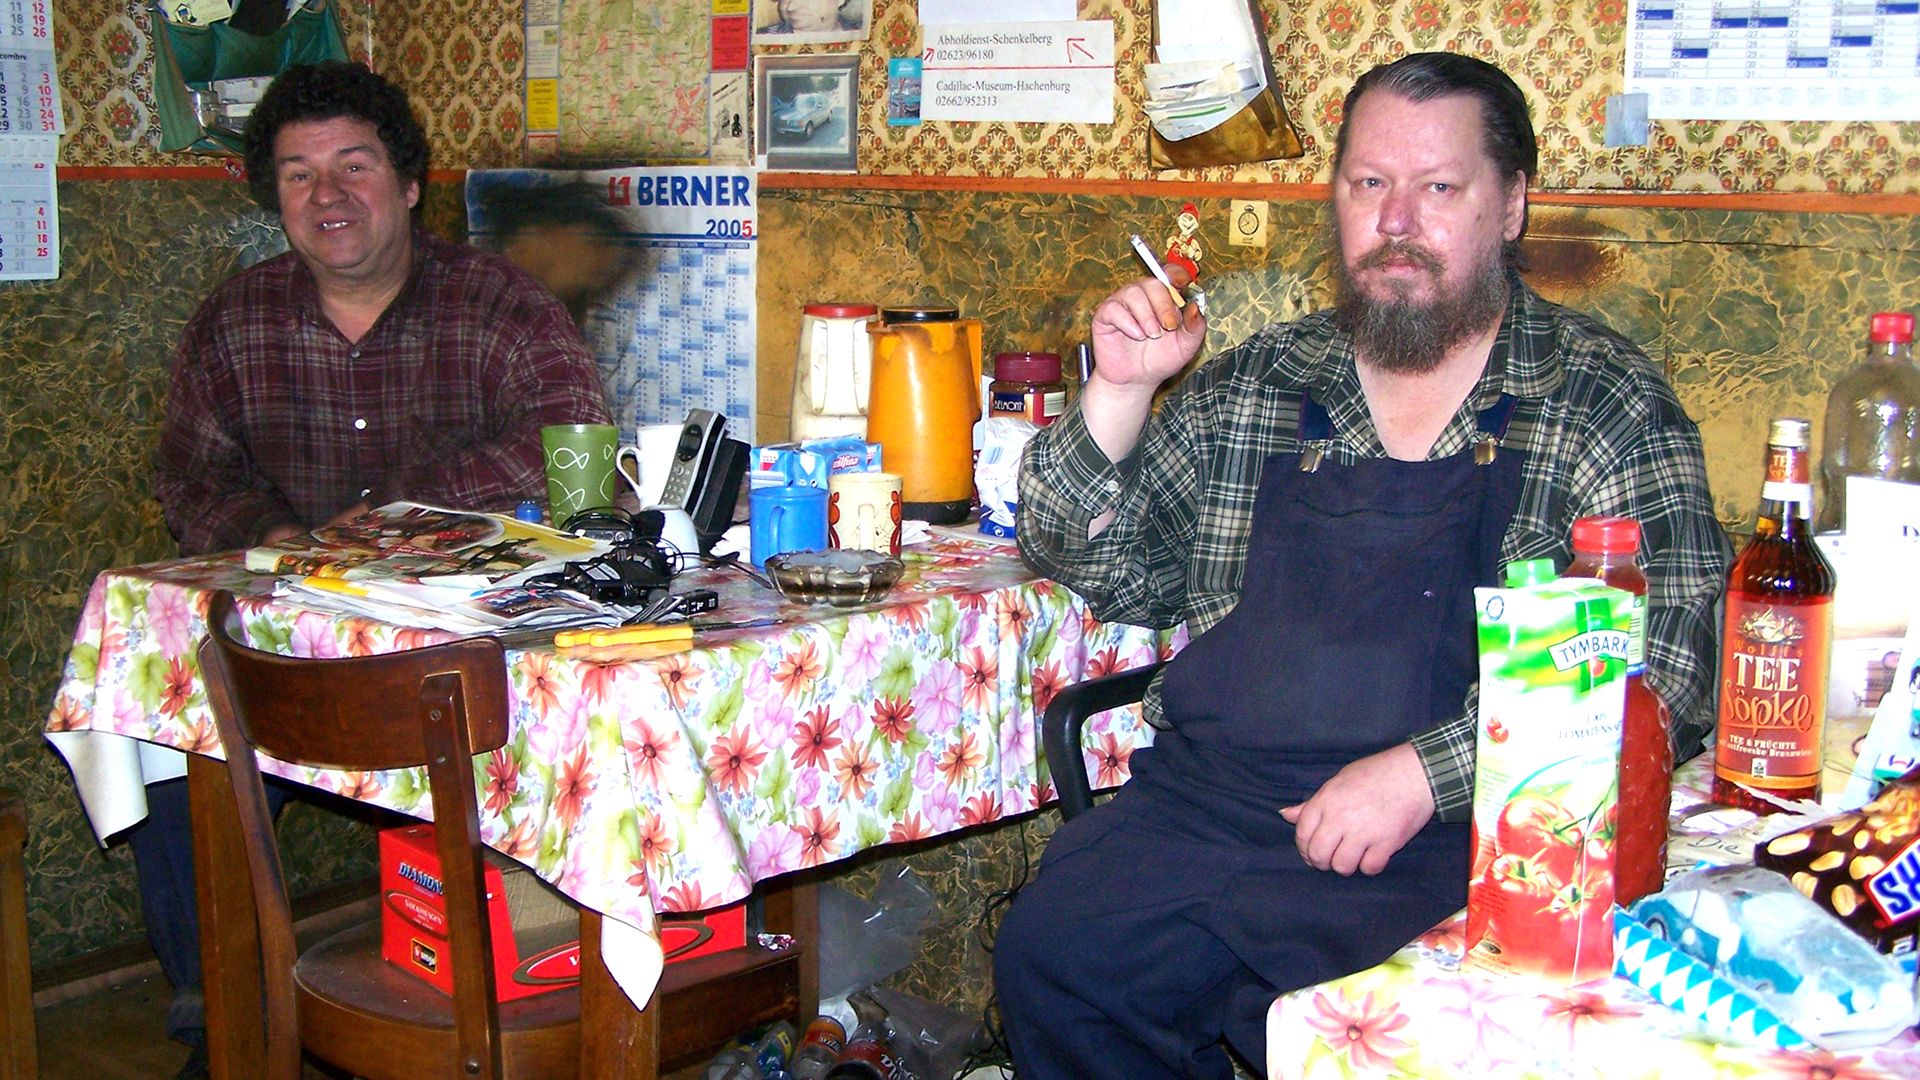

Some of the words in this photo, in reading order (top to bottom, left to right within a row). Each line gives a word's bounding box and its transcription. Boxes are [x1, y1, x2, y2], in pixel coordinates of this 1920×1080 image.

[32, 3, 44, 13] 12
[33, 15, 46, 26] 19
[32, 27, 46, 38] 26
[937, 33, 1052, 46] Abholdienst-Schenkelberg
[0, 52, 27, 60] cembre
[936, 49, 994, 60] 02623/96180
[43, 74, 50, 83] 3
[38, 86, 52, 95] 10
[936, 80, 1071, 94] Cadillac-Museum-Hachenburg
[40, 98, 52, 108] 17
[935, 96, 998, 106] 02662/952313
[40, 109, 54, 119] 24
[42, 122, 54, 131] 31
[638, 176, 751, 206] BERNER
[37, 220, 46, 230] 11
[706, 218, 752, 238] 2005
[37, 234, 48, 244] 18
[37, 247, 48, 257] 25
[1559, 636, 1629, 662] TYMBARK
[1733, 652, 1800, 692] TEE
[1730, 734, 1744, 745] TEE
[1687, 836, 1741, 855] Die
[398, 862, 444, 896] DIAMON
